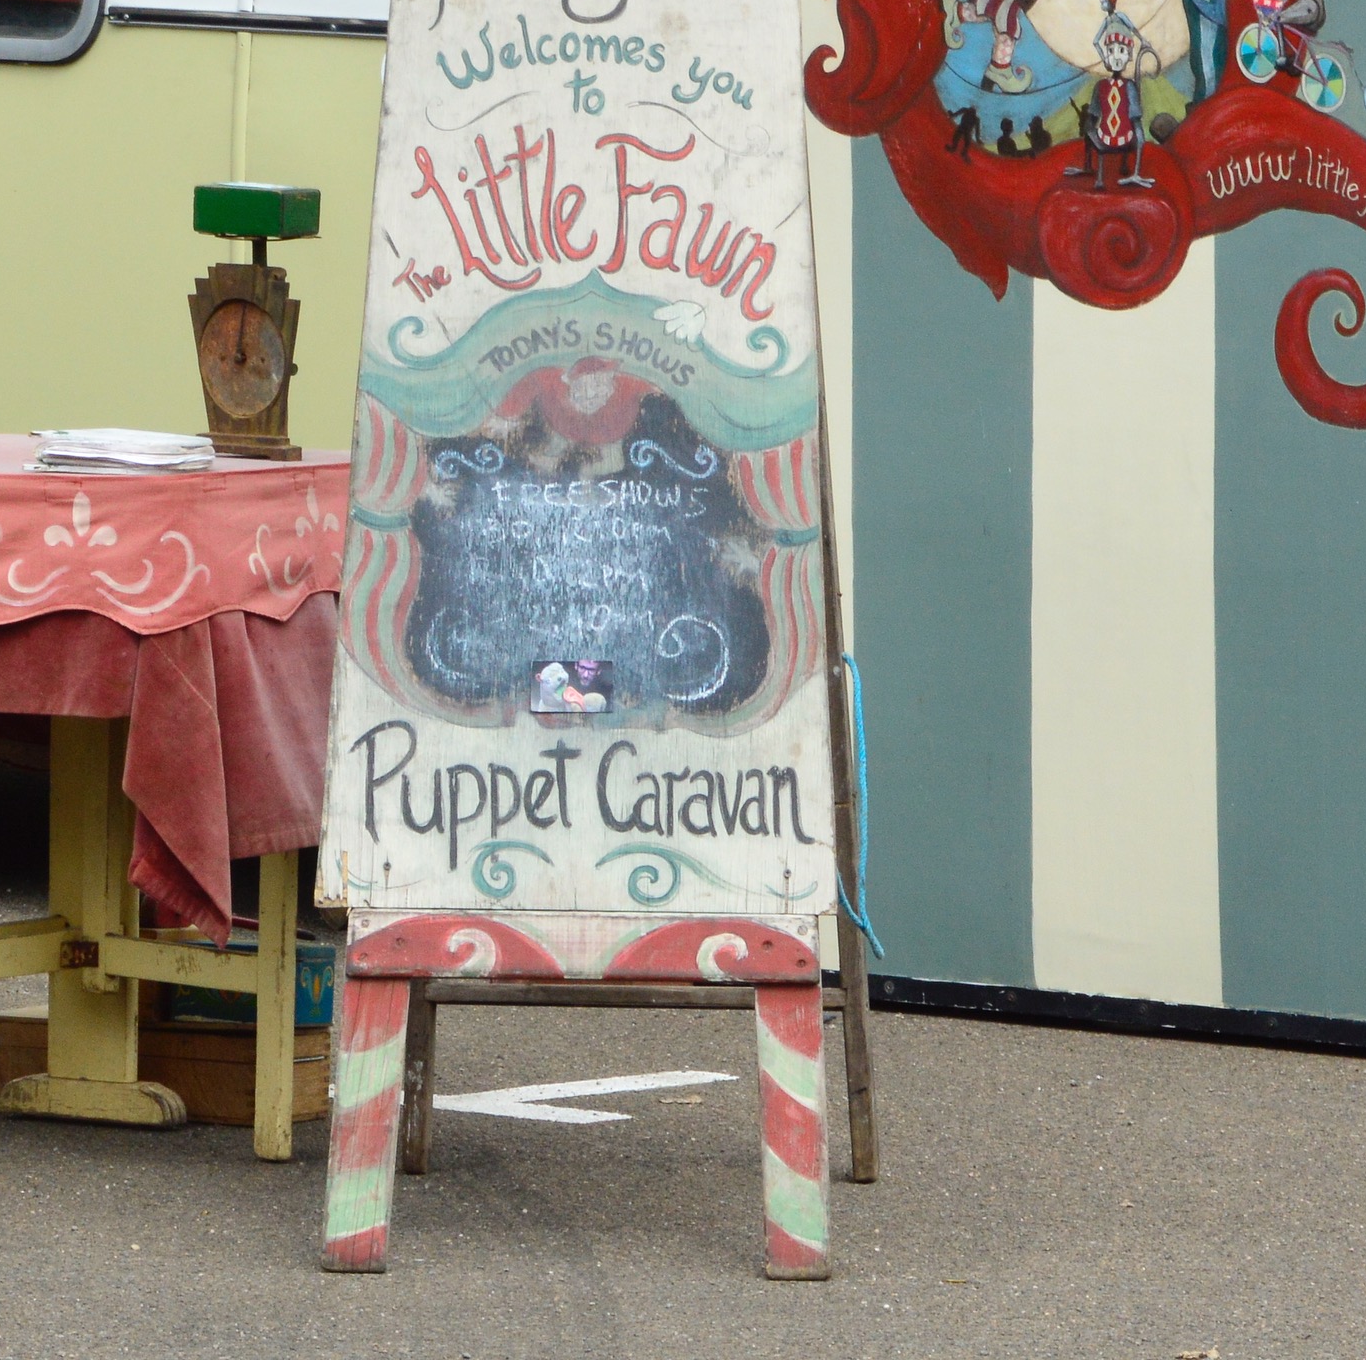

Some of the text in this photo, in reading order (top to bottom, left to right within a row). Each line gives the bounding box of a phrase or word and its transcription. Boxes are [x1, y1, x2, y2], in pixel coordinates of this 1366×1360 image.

[436, 15, 754, 111] Welcomes you
[570, 69, 606, 116] to
[392, 124, 777, 322] The Little Fawn
[593, 322, 696, 387] SHOWS
[599, 480, 709, 518] SHOWS
[349, 720, 816, 870] Puppet Caravan
